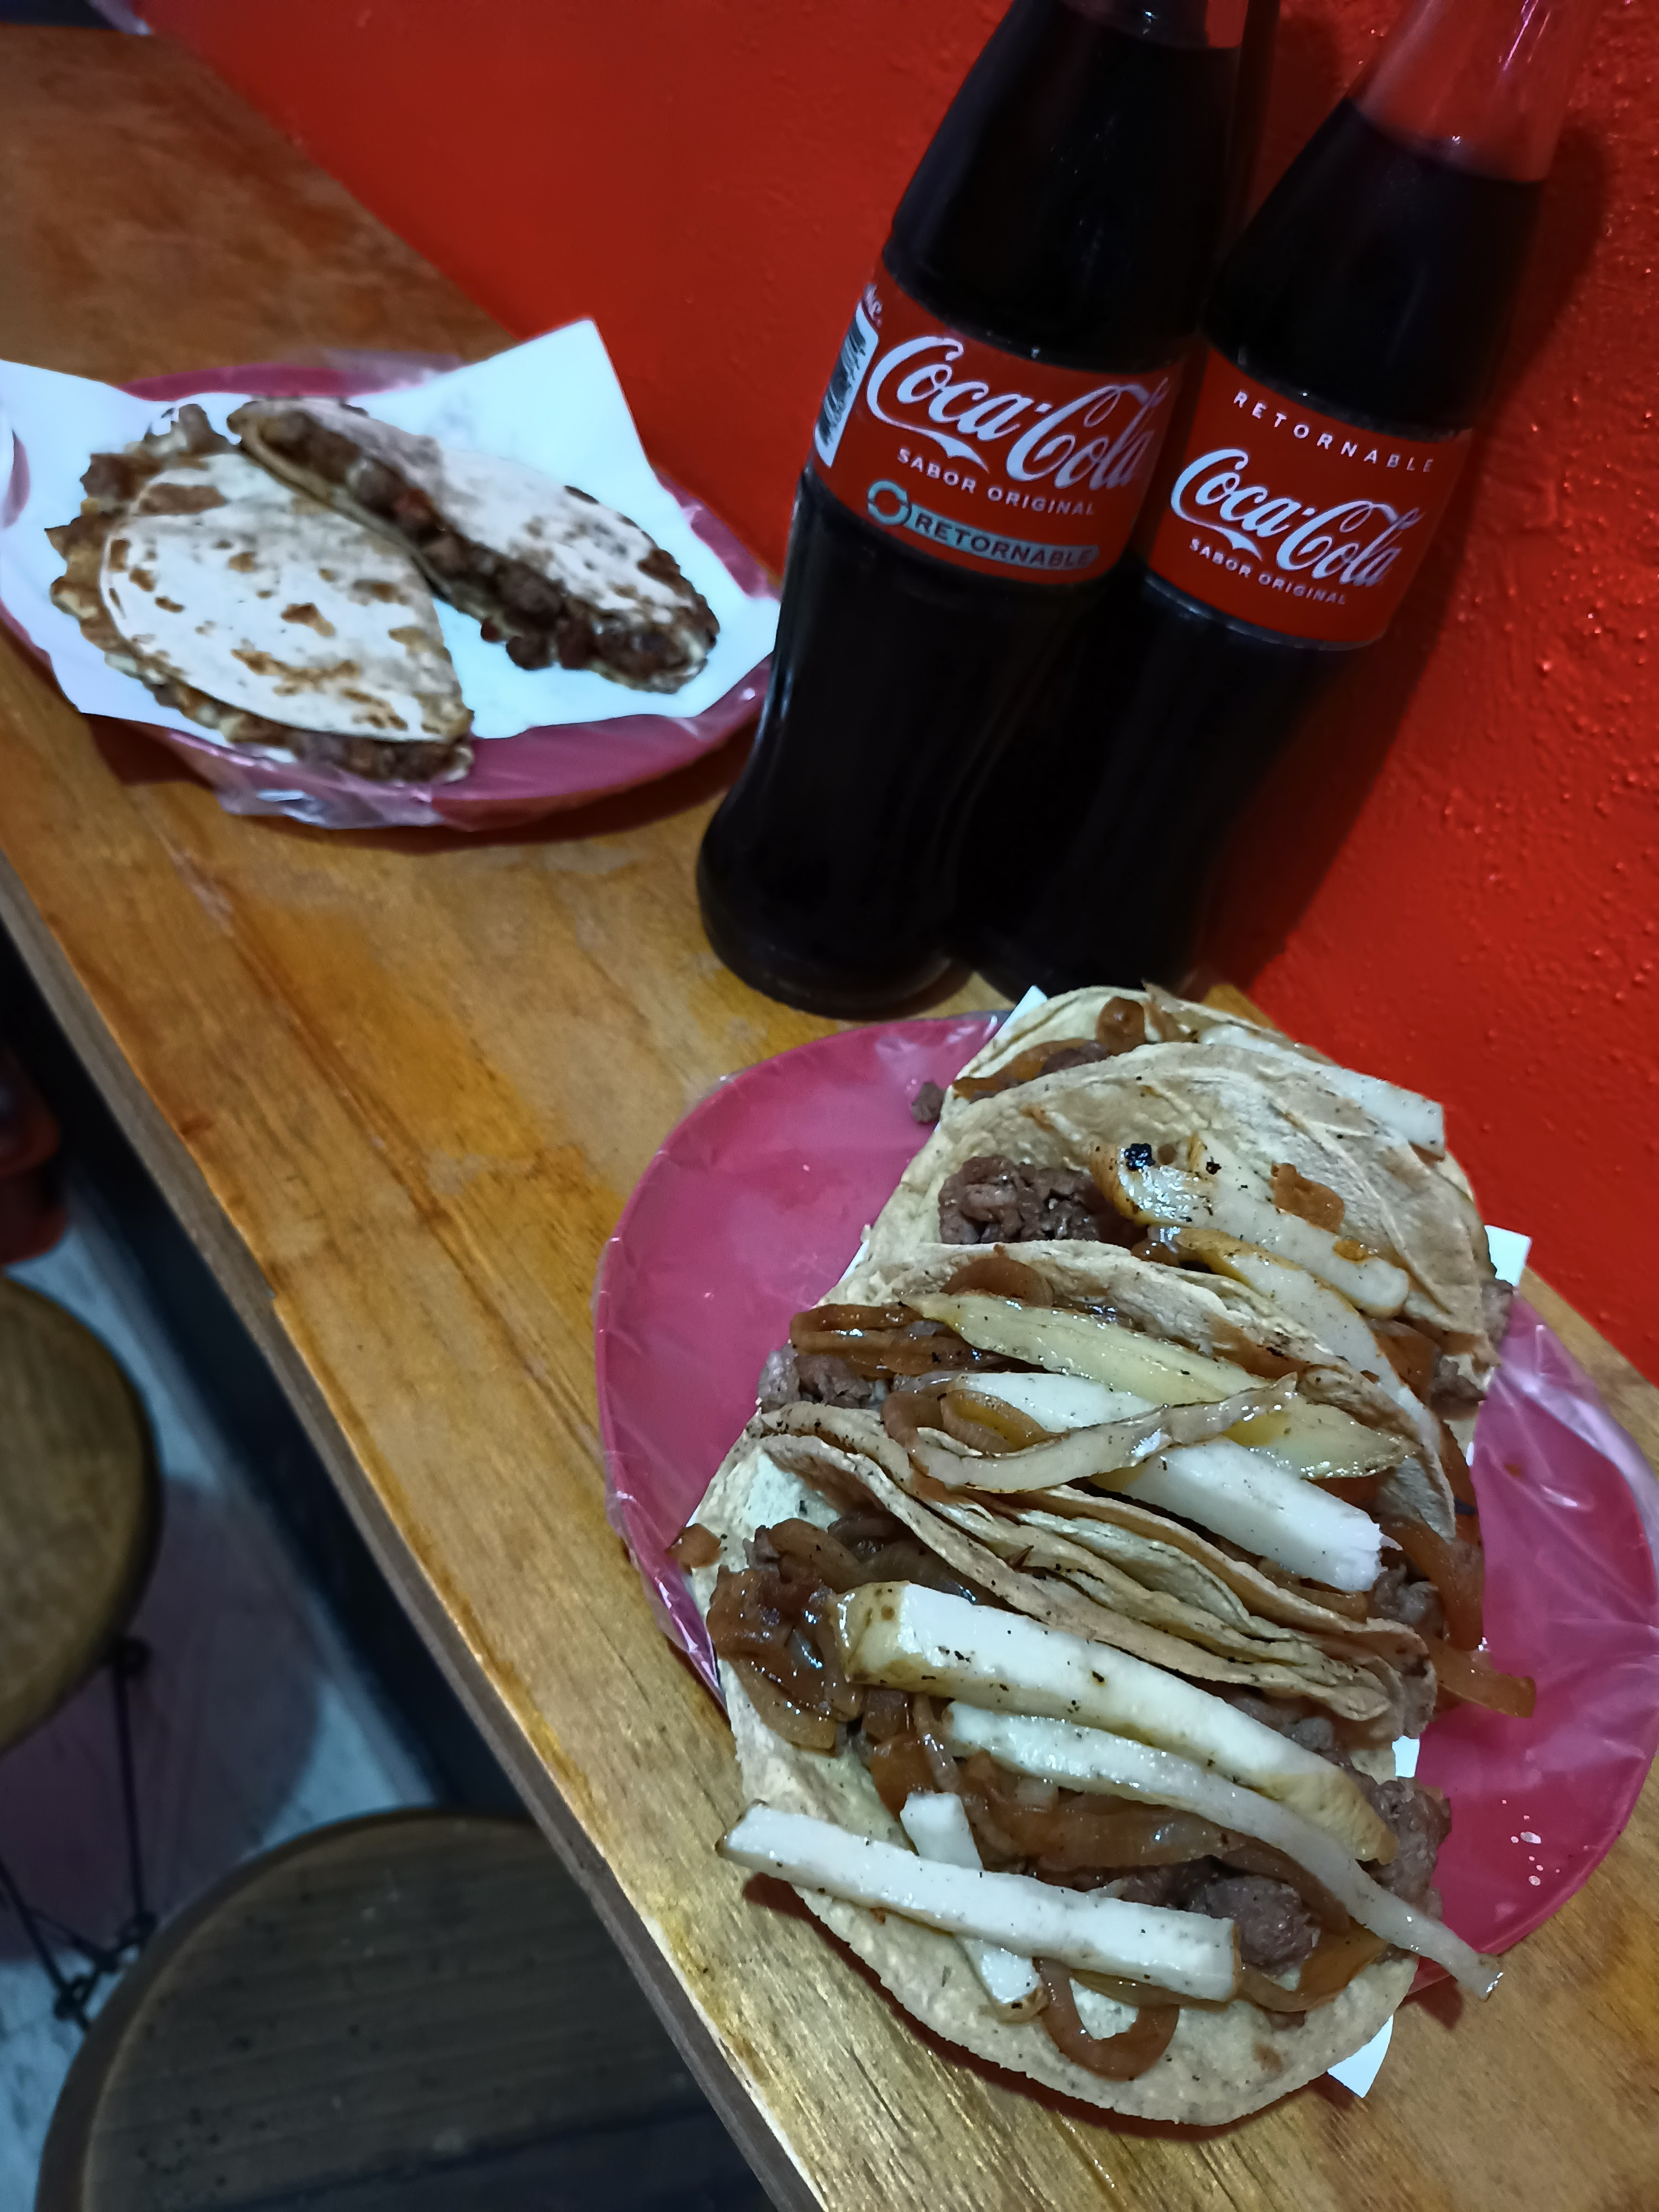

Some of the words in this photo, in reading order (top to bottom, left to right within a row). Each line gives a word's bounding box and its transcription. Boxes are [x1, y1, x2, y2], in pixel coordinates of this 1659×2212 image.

[1233, 390, 1434, 473] RETORNABLE
[898, 447, 976, 494] SABOR
[987, 486, 1095, 516] ORIGINAL
[915, 512, 1092, 567] RETORNABLE
[1170, 448, 1425, 586] Coca-Cola
[1190, 538, 1252, 578] SABOR
[1258, 572, 1346, 604] ORIGINAL
